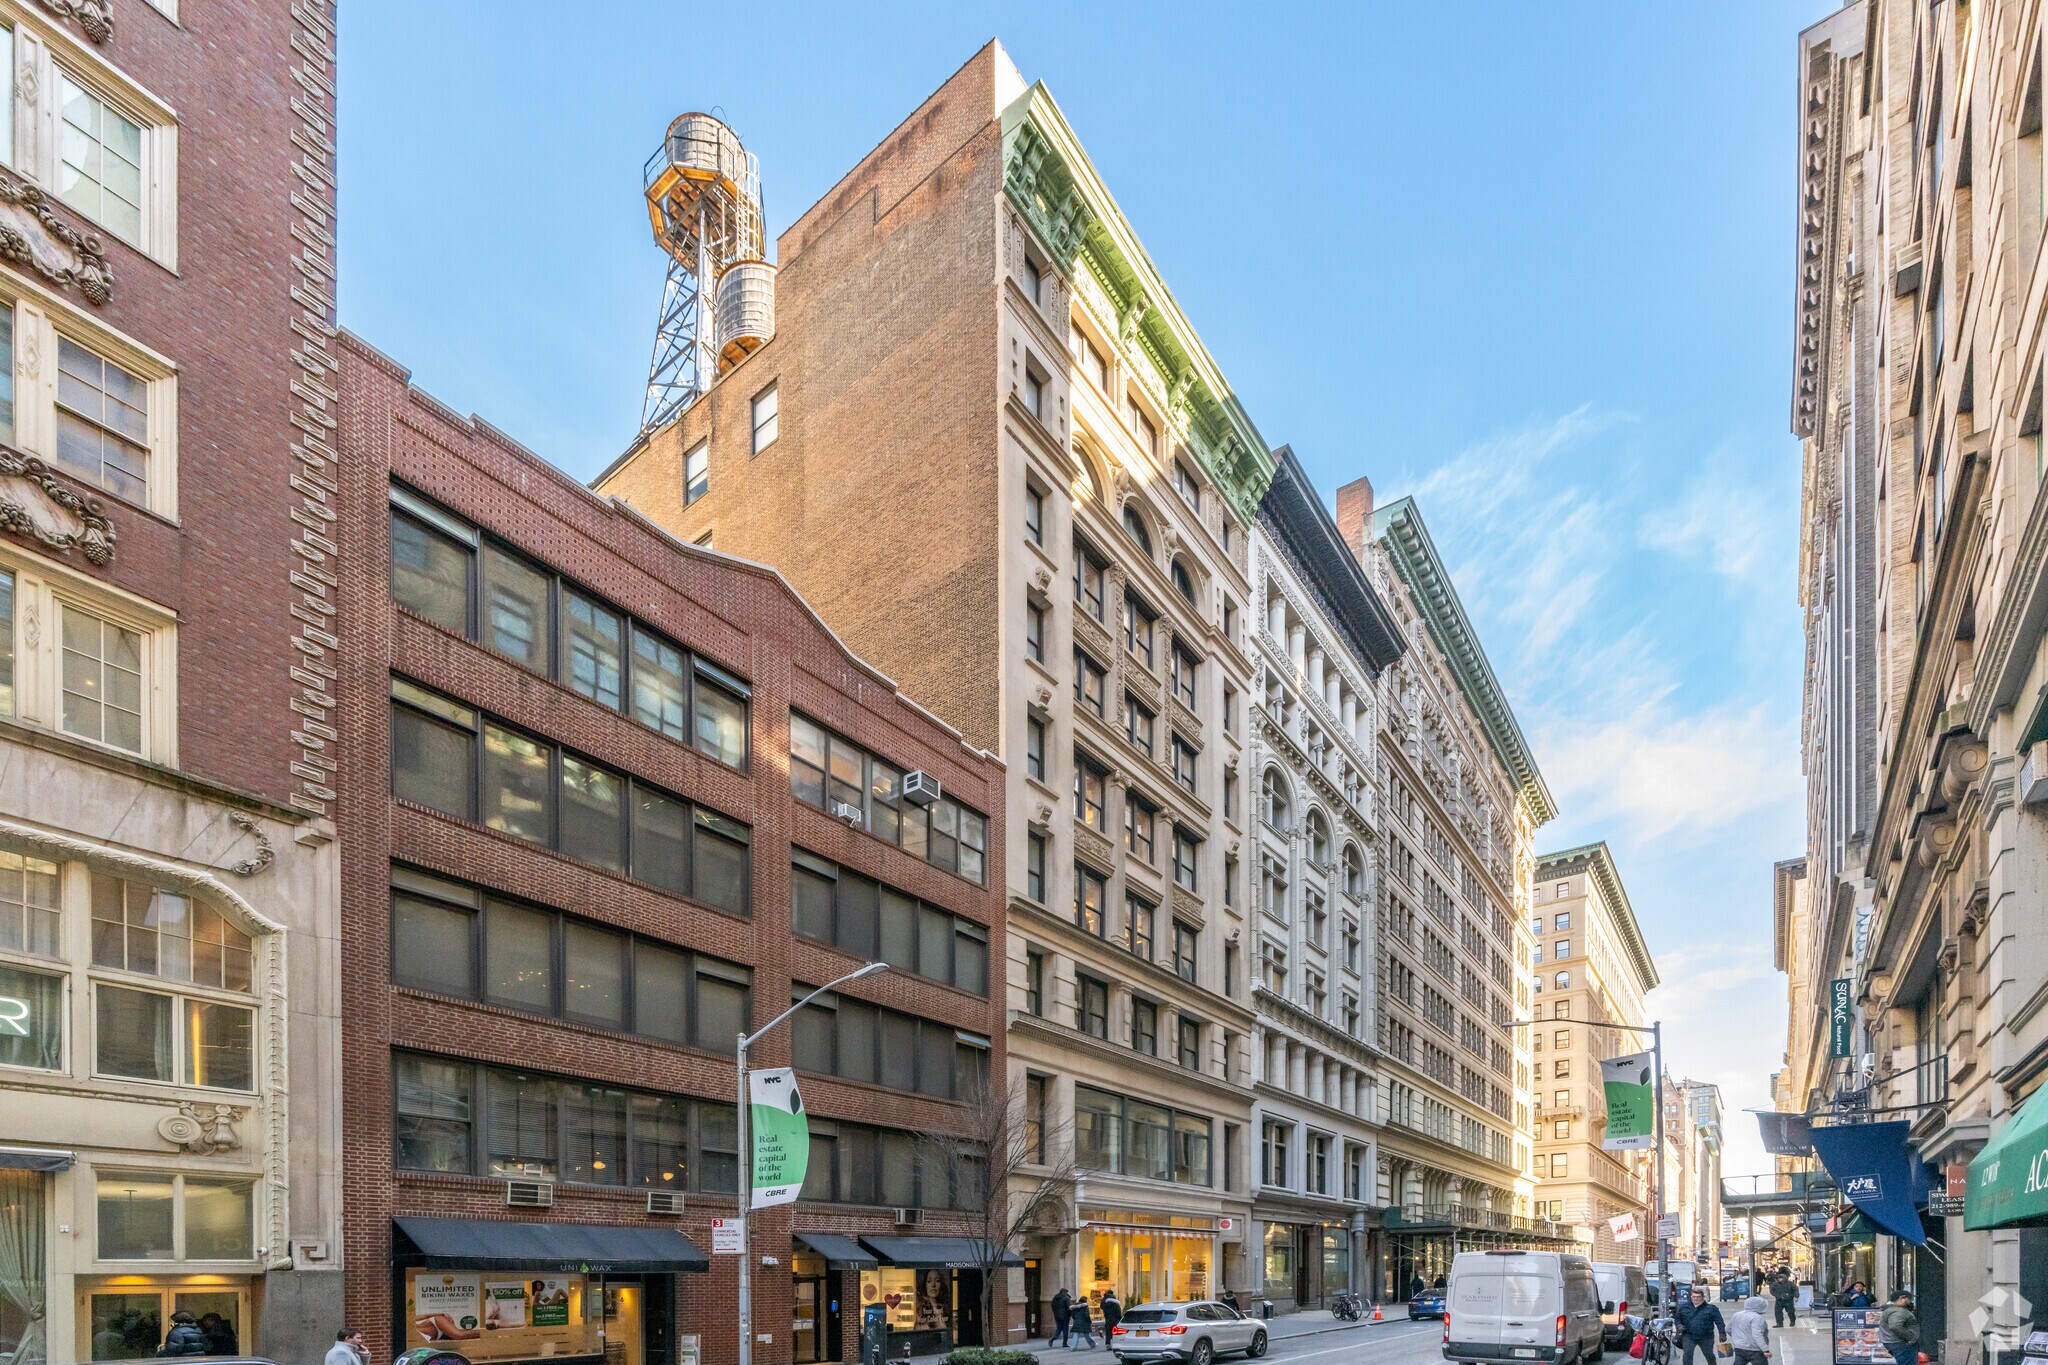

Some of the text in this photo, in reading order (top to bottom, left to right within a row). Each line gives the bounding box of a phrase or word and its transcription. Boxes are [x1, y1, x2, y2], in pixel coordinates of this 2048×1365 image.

[1834, 982, 1847, 1024] SUNAC
[764, 1076, 781, 1084] NYC
[1611, 1101, 1627, 1109] Real
[1611, 1114, 1635, 1122] capital
[1611, 1121, 1619, 1129] of
[759, 1134, 778, 1143] Real
[759, 1154, 786, 1163] capital
[758, 1164, 767, 1172] of
[758, 1173, 781, 1181] world
[765, 1189, 787, 1197] CBRE
[1616, 1221, 1633, 1234] H&M
[421, 1285, 475, 1293] UNLIMITED
[868, 1314, 873, 1322] P
